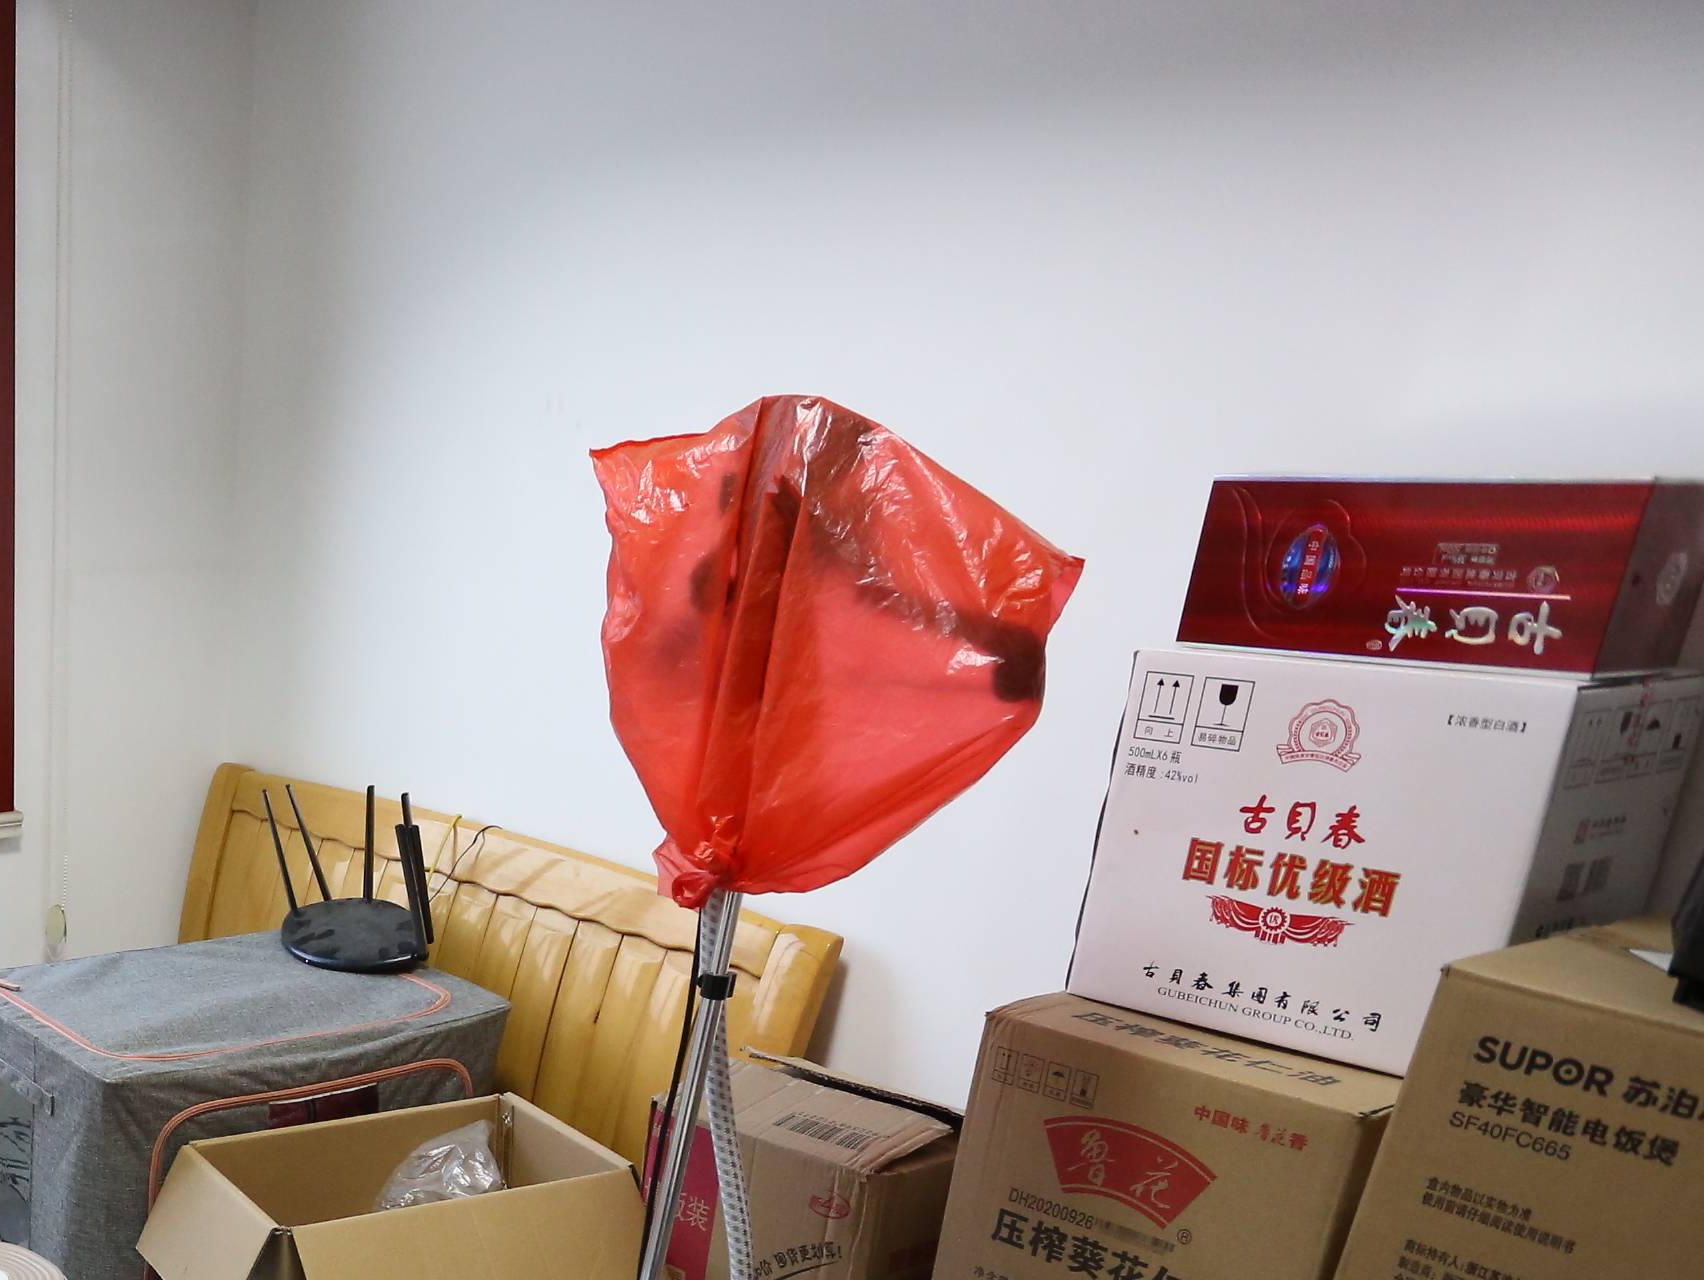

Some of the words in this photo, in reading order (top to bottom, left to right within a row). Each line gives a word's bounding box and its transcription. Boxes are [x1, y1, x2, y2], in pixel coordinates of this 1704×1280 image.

[1384, 594, 1563, 656] 古贝春
[1197, 732, 1237, 747] 易碎物品
[1239, 794, 1366, 849] 古贝春
[1181, 837, 1403, 918] 国标优级酒
[1157, 986, 1239, 1014] GUBEICHUN
[1241, 1006, 1292, 1026] GROUP
[1473, 1035, 1615, 1098] SUPOR
[1622, 1075, 1704, 1121] 苏泊
[1194, 1105, 1251, 1135] 中国味
[1449, 1110, 1572, 1162] SF40FC665
[1457, 1080, 1680, 1167] 豪华智能电饭煲
[1067, 1129, 1181, 1210] 鲁花
